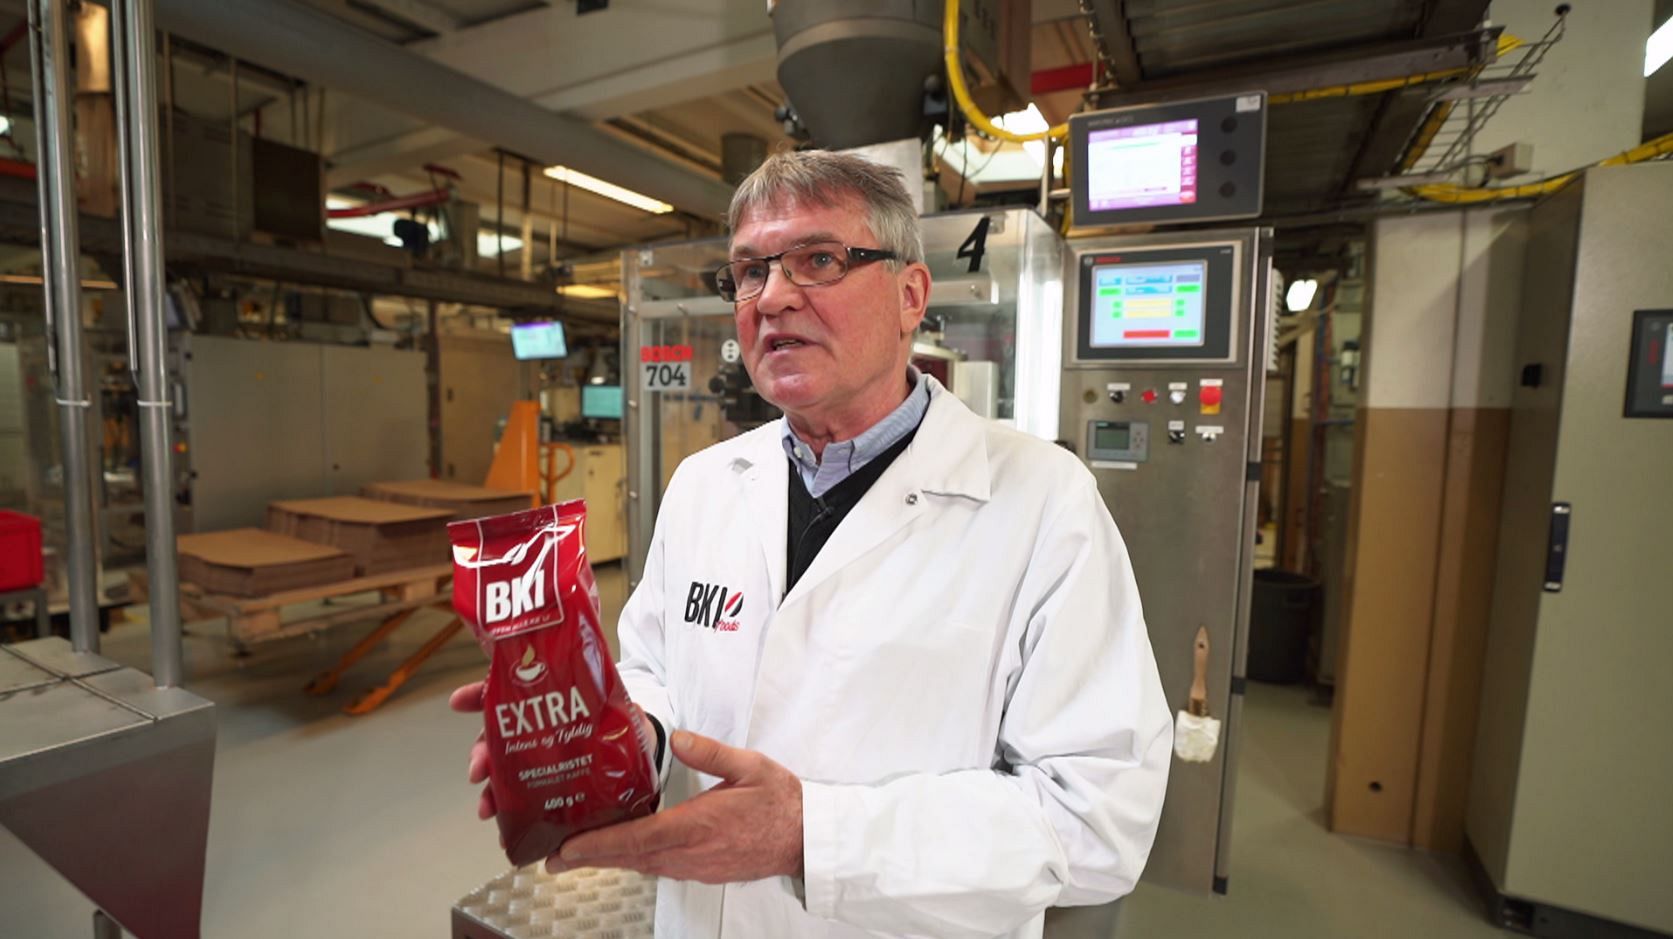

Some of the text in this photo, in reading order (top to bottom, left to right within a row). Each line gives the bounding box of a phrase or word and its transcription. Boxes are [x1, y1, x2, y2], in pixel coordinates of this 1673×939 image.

[955, 215, 991, 273] 4
[646, 364, 686, 387] 704
[486, 570, 545, 625] BKI
[684, 581, 728, 629] BKI
[495, 685, 590, 738] EXTRA
[541, 734, 555, 749] og
[518, 753, 593, 781] SPECIALRISTET
[544, 796, 564, 811] 400
[566, 795, 574, 808] g
